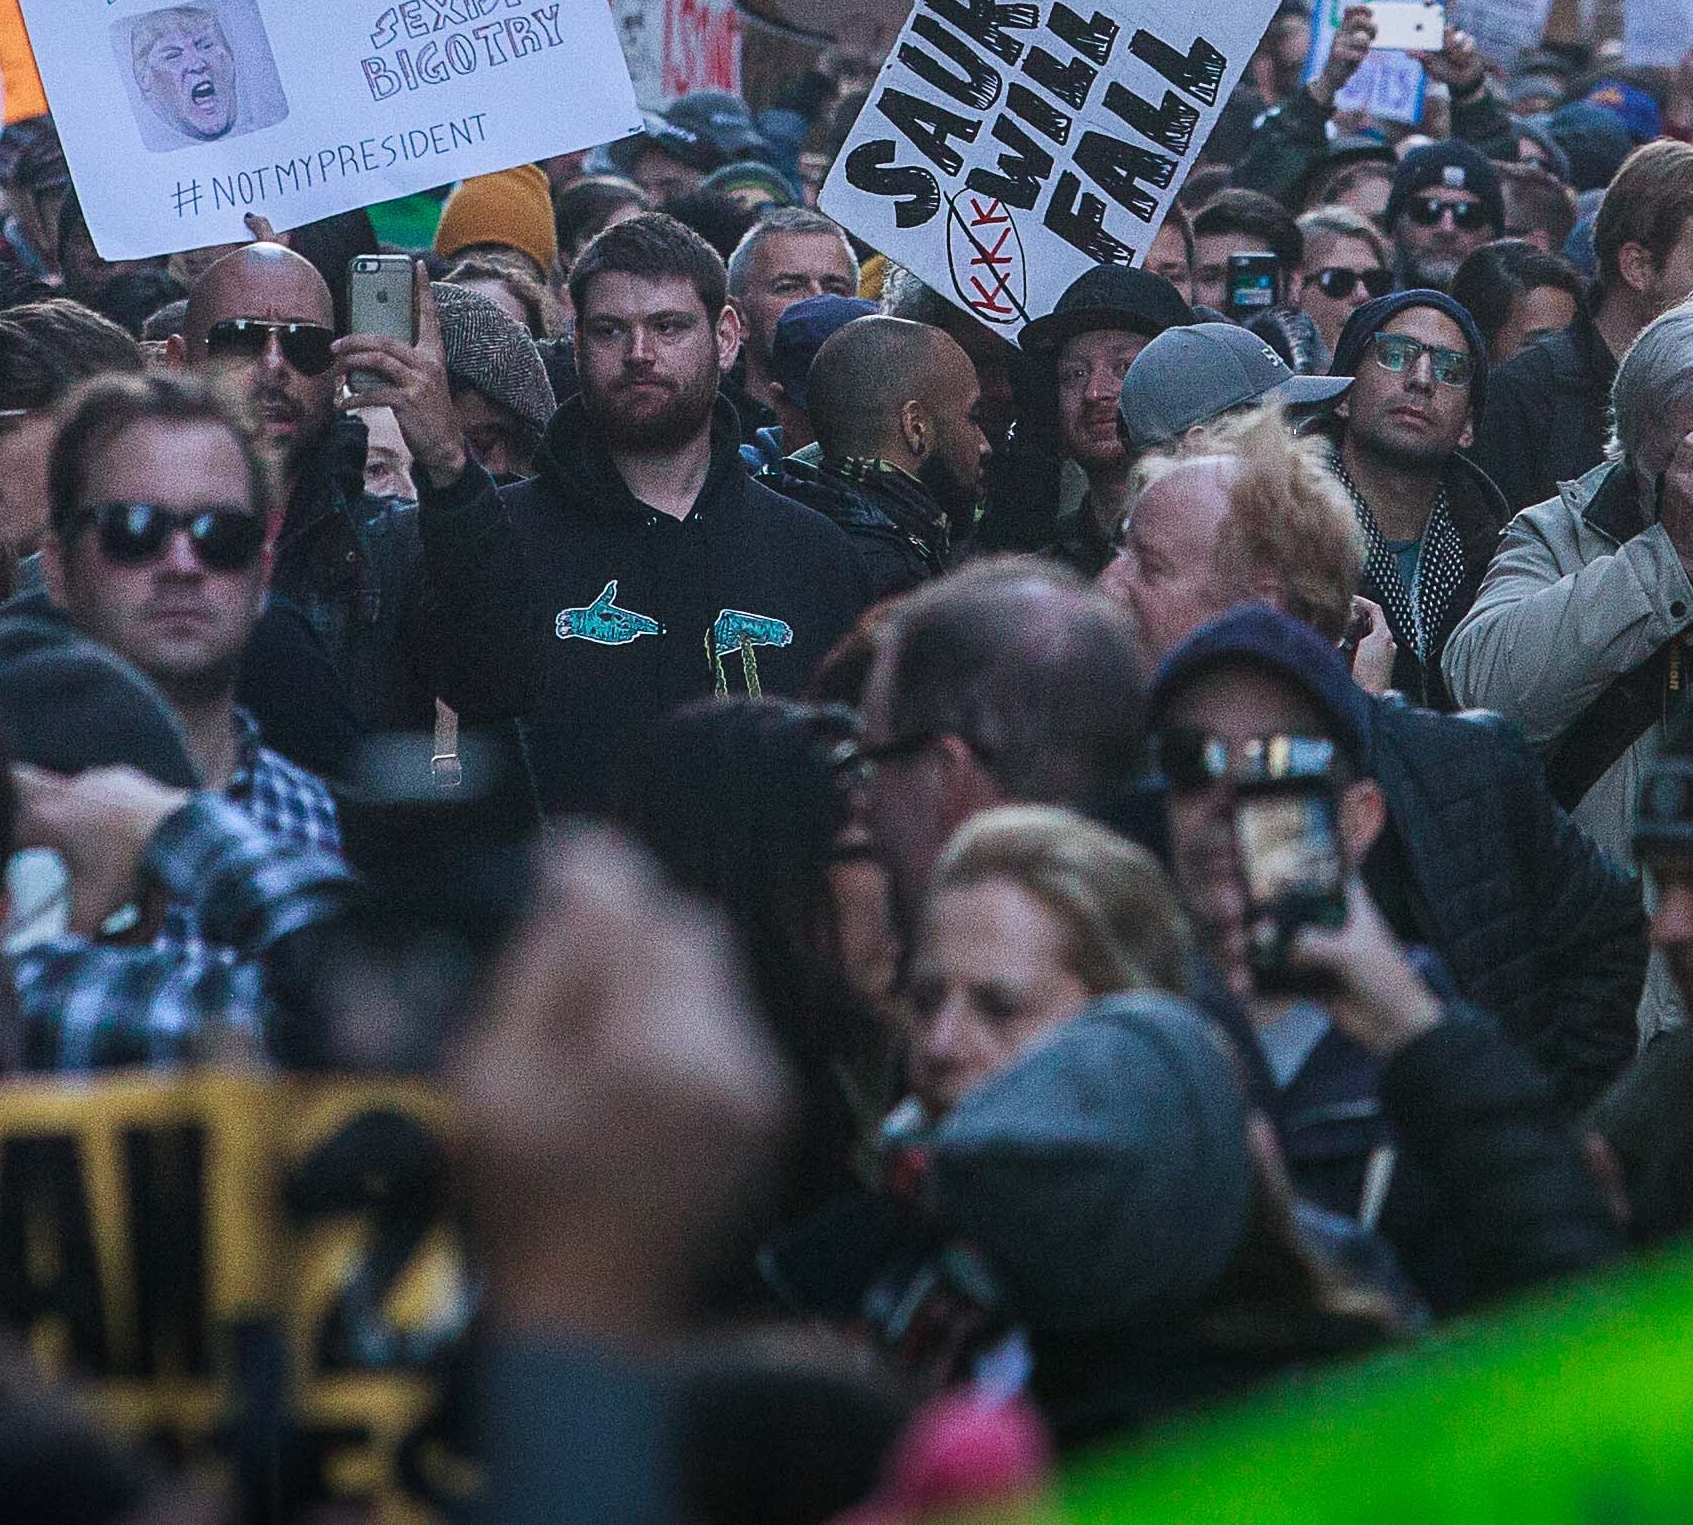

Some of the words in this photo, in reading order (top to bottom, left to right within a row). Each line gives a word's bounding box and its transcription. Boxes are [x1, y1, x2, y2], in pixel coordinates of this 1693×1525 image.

[361, 3, 564, 102] BIGOTRY
[966, 1, 1120, 212] WILL
[170, 112, 487, 218] #NOTMYPRESIDENT
[1043, 28, 1228, 268] FALL
[969, 197, 1013, 314] KKK
